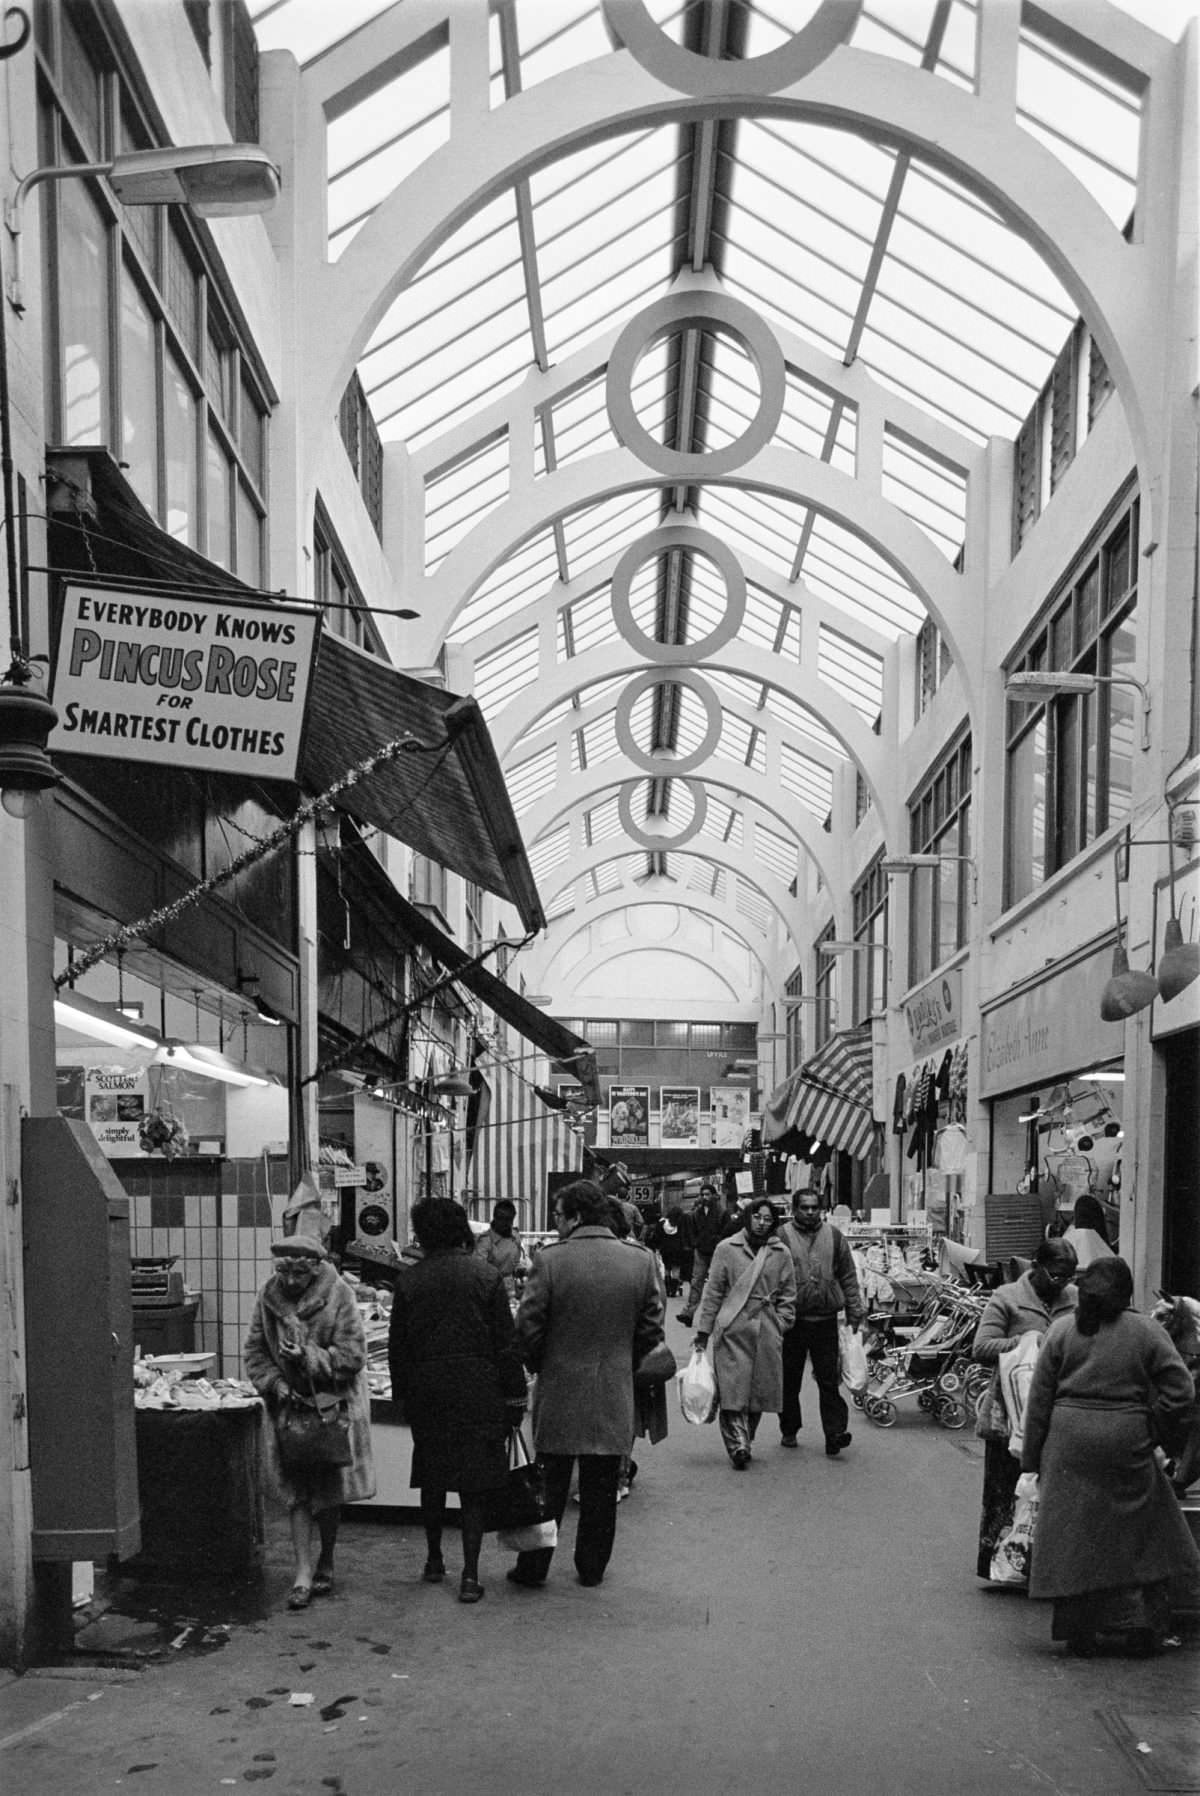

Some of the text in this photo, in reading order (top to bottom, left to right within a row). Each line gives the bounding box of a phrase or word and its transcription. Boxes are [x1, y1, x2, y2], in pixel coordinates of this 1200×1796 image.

[78, 597, 296, 645] EVERYBODY KNOWS
[69, 627, 297, 702] PINCUS ROSE
[156, 694, 194, 709] FOR
[63, 702, 285, 756] SMARTEST CLOTHES
[98, 1134, 135, 1143] delightful
[105, 1127, 129, 1135] simply
